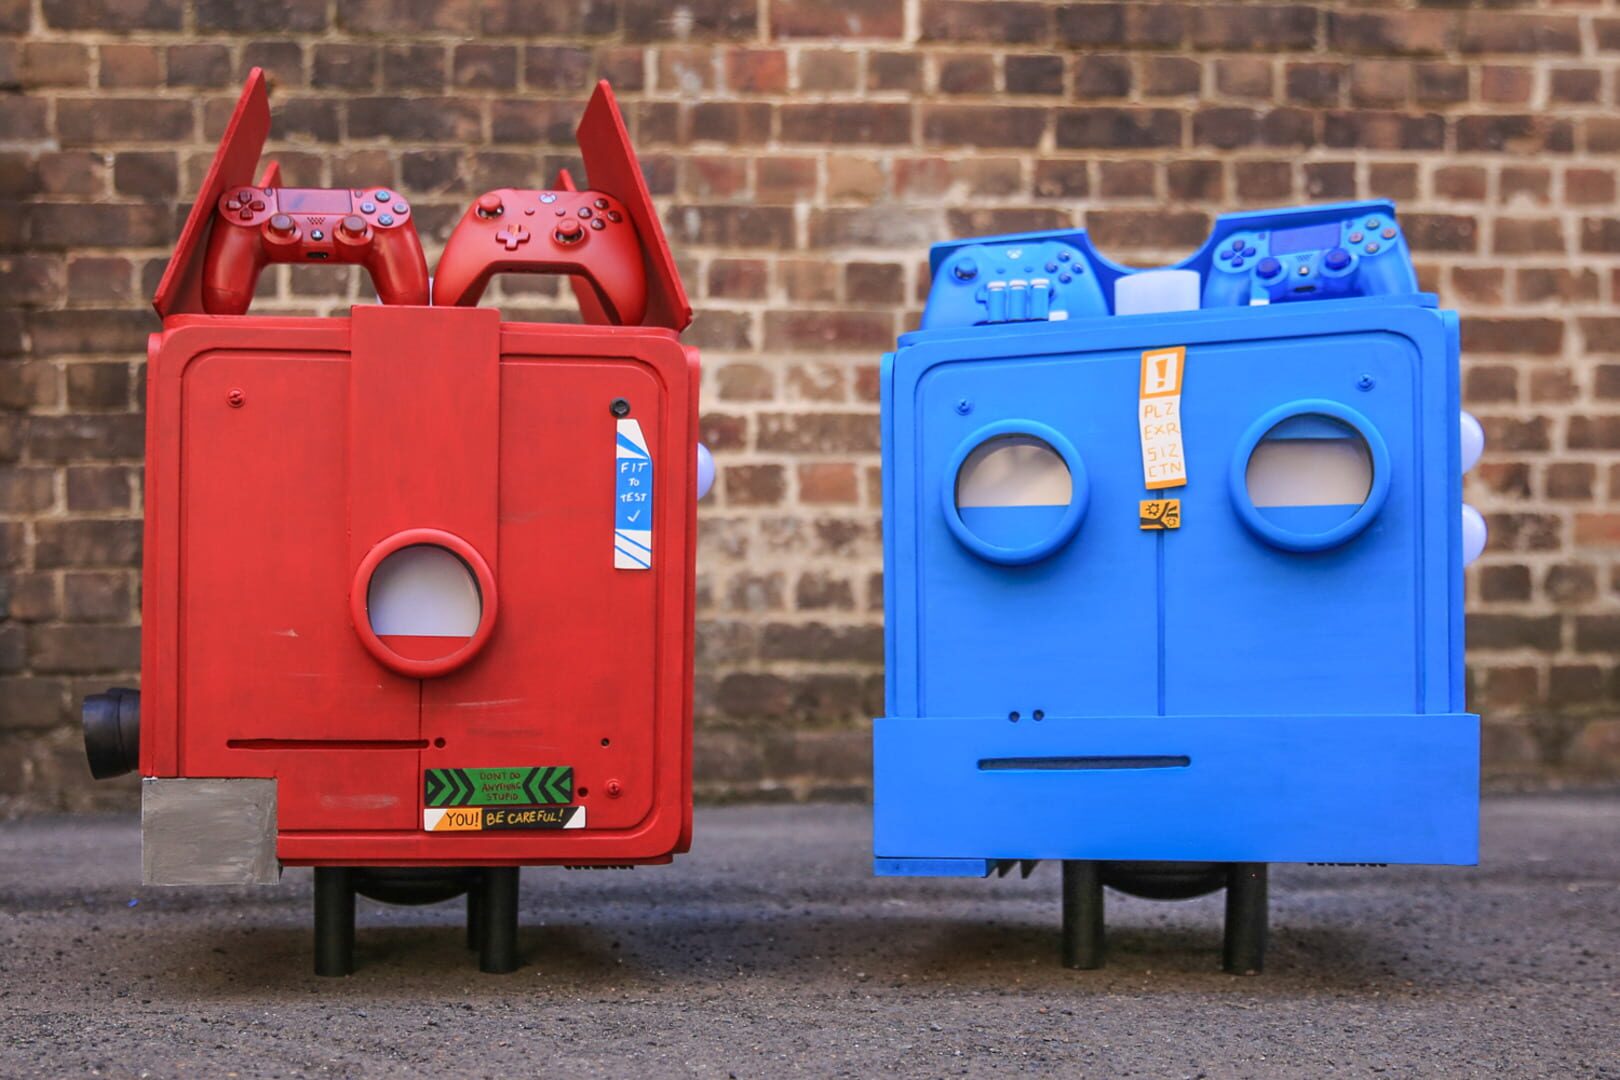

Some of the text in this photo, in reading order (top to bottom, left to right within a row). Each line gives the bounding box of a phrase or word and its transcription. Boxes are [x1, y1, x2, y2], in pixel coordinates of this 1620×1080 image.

[1144, 402, 1174, 418] PLZ
[1144, 422, 1179, 440] EXR
[621, 462, 649, 473] FIT
[1149, 461, 1182, 478] CTN
[628, 477, 640, 487] TO
[620, 492, 648, 503] TEST
[510, 772, 521, 780] DO
[482, 783, 521, 792] ANYTHING
[487, 793, 519, 801] STUPID
[445, 809, 564, 827] YOU! BE CAREFUL!
